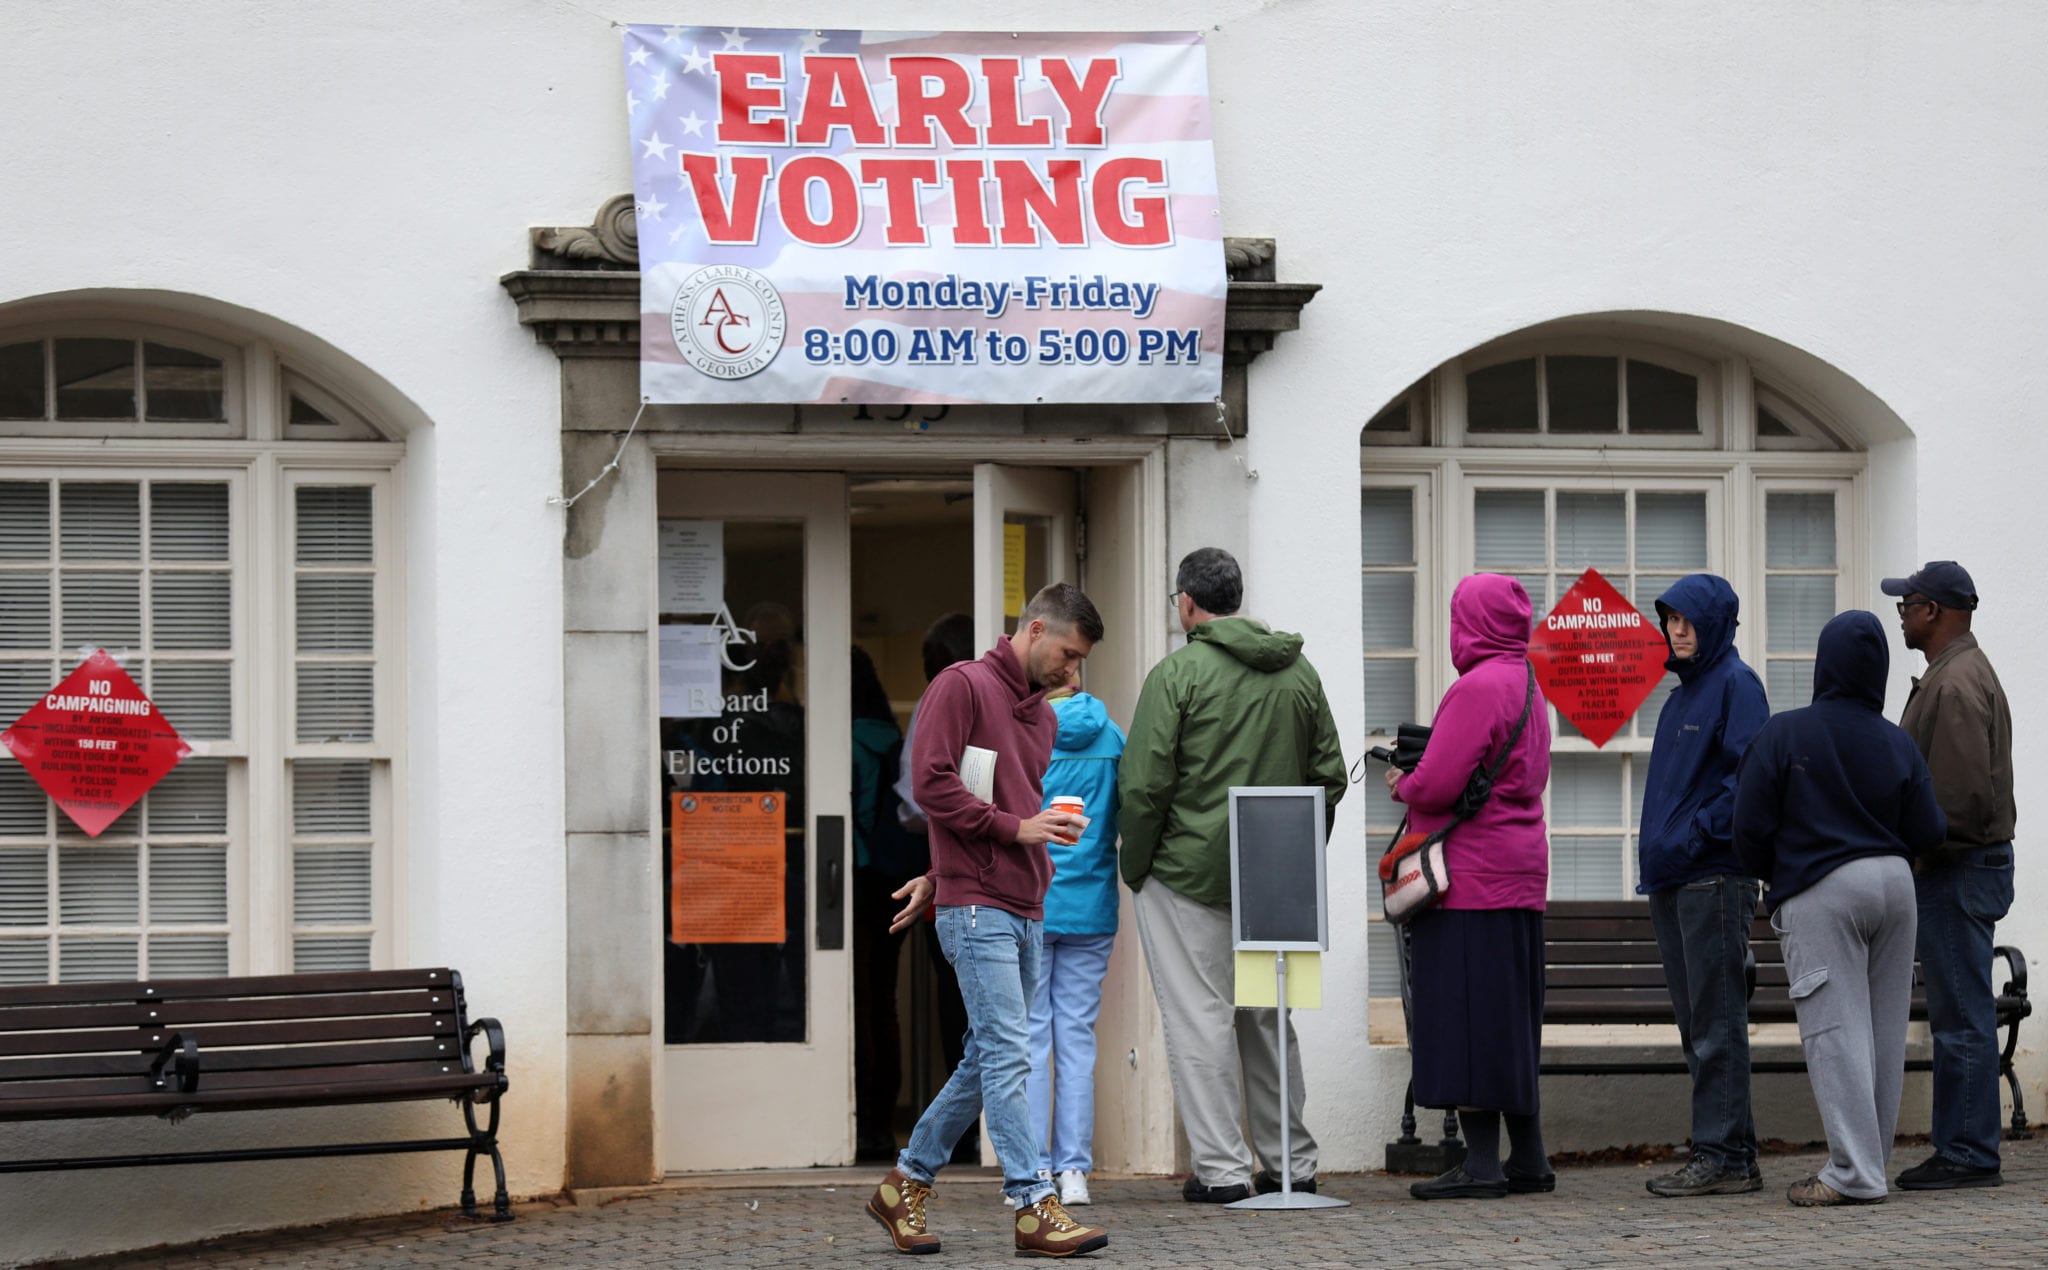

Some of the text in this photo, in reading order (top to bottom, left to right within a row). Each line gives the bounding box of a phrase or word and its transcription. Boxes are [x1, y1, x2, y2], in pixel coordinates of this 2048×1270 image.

[711, 52, 1122, 149] EARLY
[680, 151, 1175, 249] VOTING
[843, 272, 1159, 318] Monday-Friday
[755, 280, 782, 343] COUNTY
[803, 326, 1201, 364] 8:00 AM to 5:00 PM
[696, 356, 763, 376] GEORGIA
[1583, 597, 1602, 613] NO
[1547, 612, 1641, 631] CAMPAIGNING
[1572, 631, 1617, 640] BY ANYONE
[1550, 655, 1579, 665] WITHIN
[1597, 653, 1615, 663] FEET
[1617, 654, 1626, 662] OF
[1629, 652, 1643, 661] THE
[1558, 665, 1637, 676] OUTER EDGE OF ANY
[88, 679, 112, 696] NO
[1549, 675, 1646, 688] BUILDING WITHIN WHICH
[688, 687, 769, 713] Board
[1578, 688, 1619, 697] A POLLING
[46, 694, 151, 717] CAMPAIGNING
[1582, 699, 1617, 709] PLACE IS
[72, 714, 124, 725] BY ANYONE
[1572, 711, 1625, 722] ESTABLISHED
[712, 718, 744, 744] of
[78, 739, 95, 750] 150
[96, 740, 118, 751] FEET
[51, 749, 141, 765] OUTER EDGE OF ANY
[668, 748, 791, 775] Elections
[41, 761, 83, 773] BUILDING
[85, 763, 118, 775] WITHIN
[70, 775, 118, 787] A POLLING
[73, 787, 114, 799] PLACE IS
